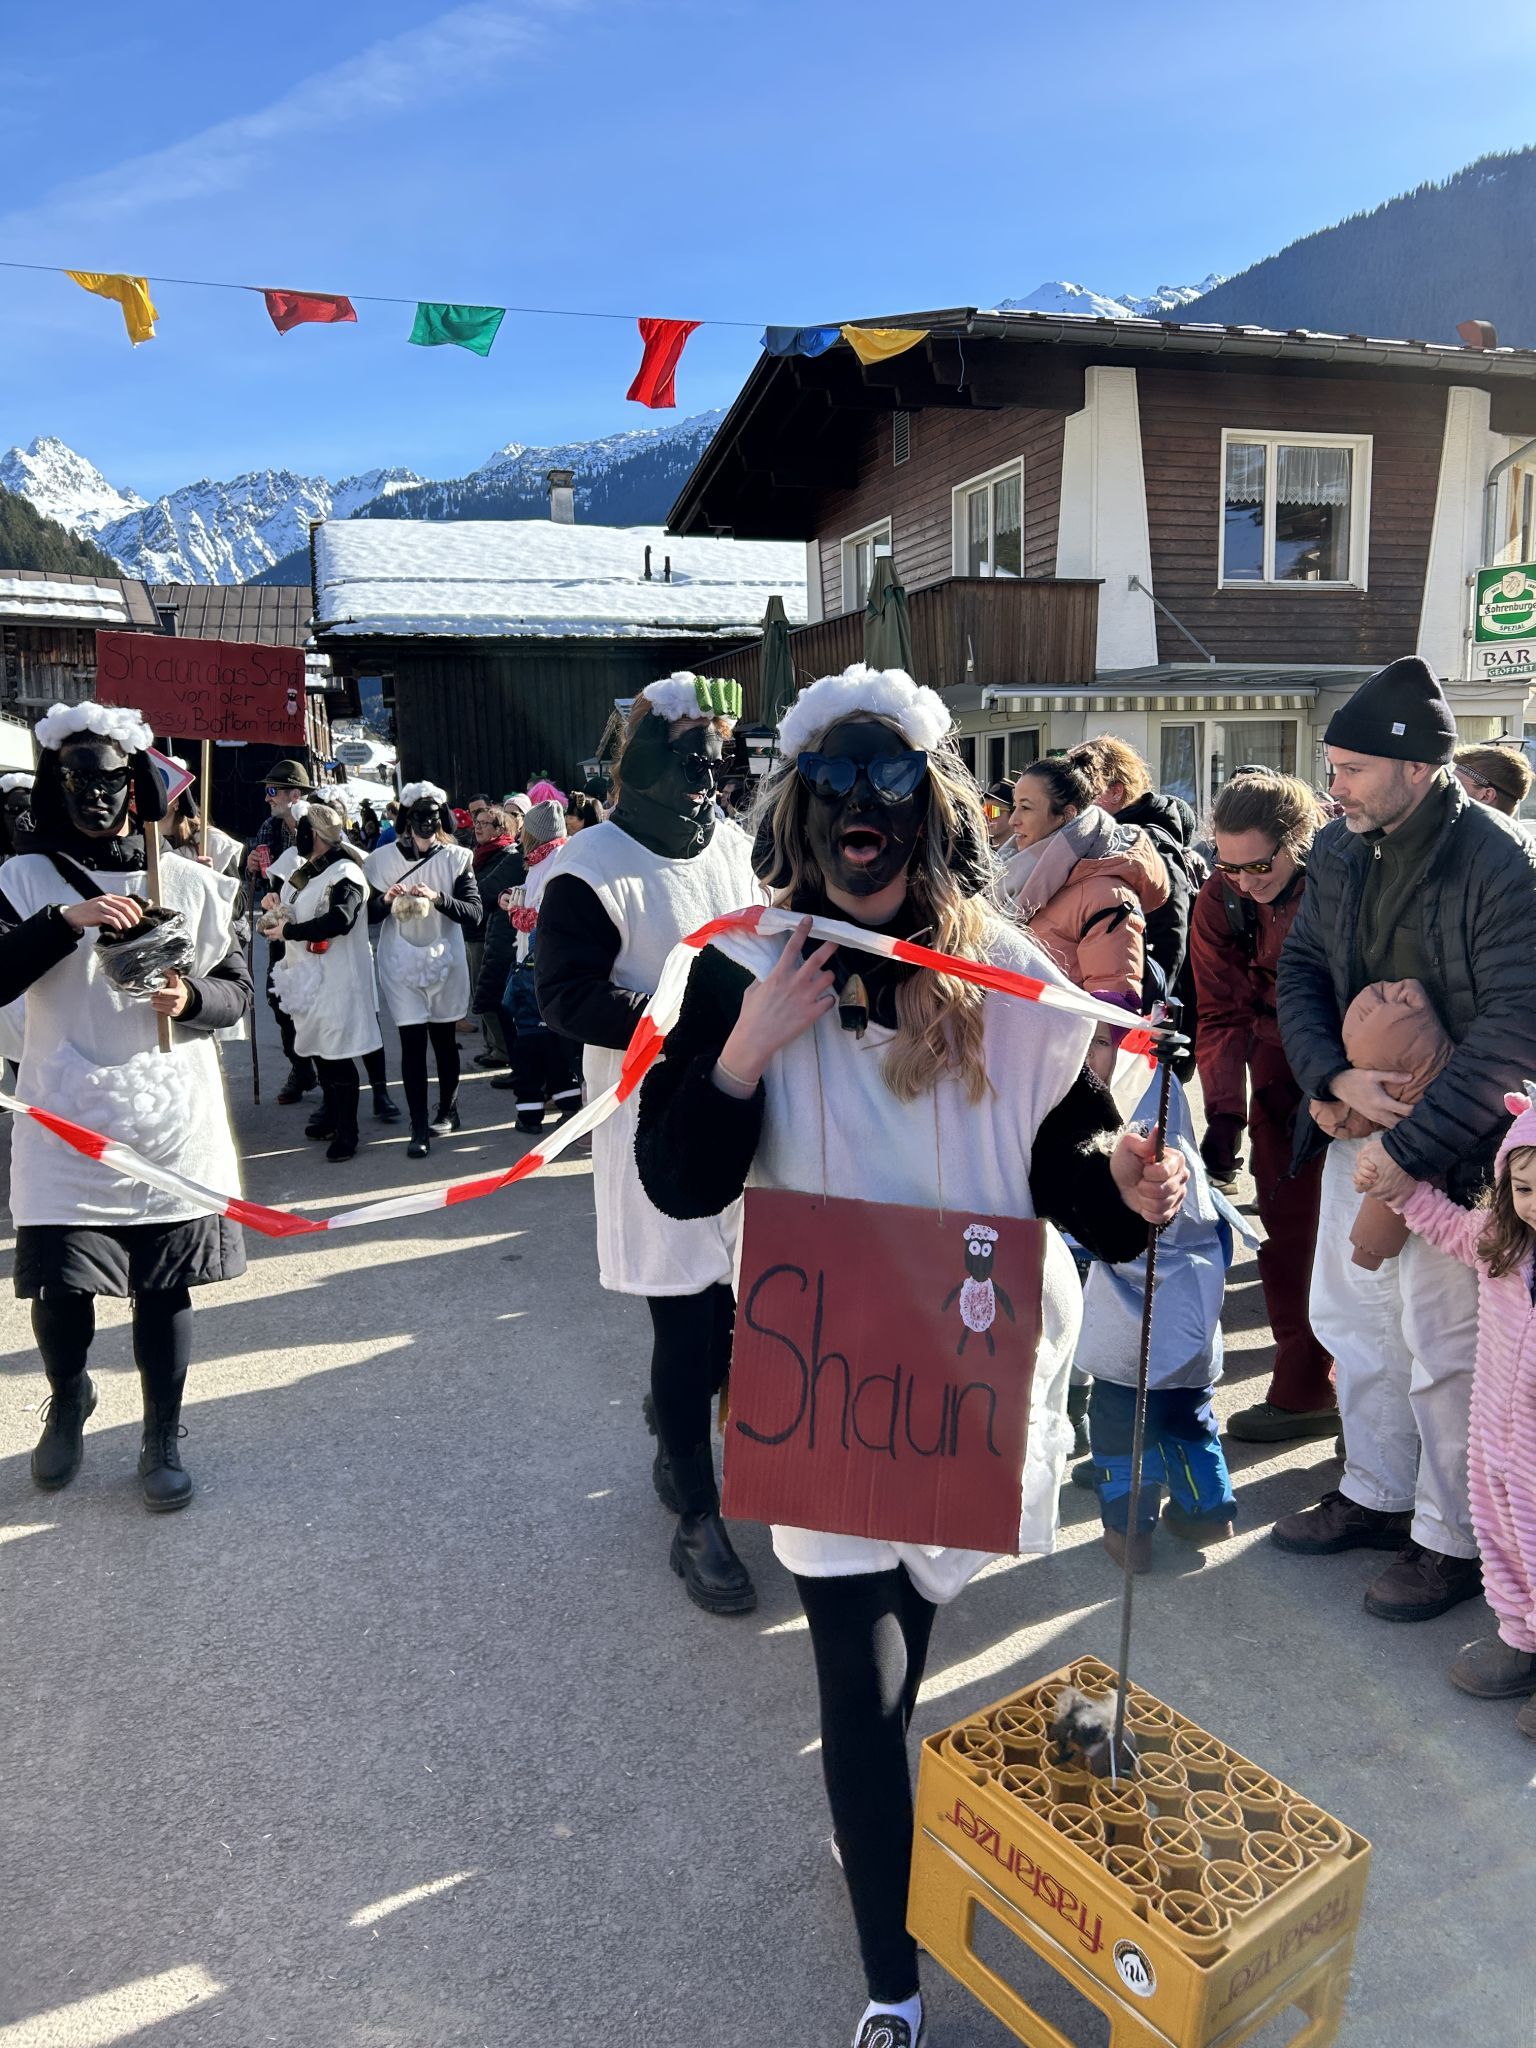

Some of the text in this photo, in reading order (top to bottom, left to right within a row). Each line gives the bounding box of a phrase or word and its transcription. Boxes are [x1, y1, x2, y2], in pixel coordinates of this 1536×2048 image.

[104, 638, 304, 687] Shaun das Schaf
[1483, 649, 1531, 666] BAR
[173, 686, 255, 706] von der
[192, 707, 258, 734] Bottom
[736, 1263, 1001, 1460] Shaun
